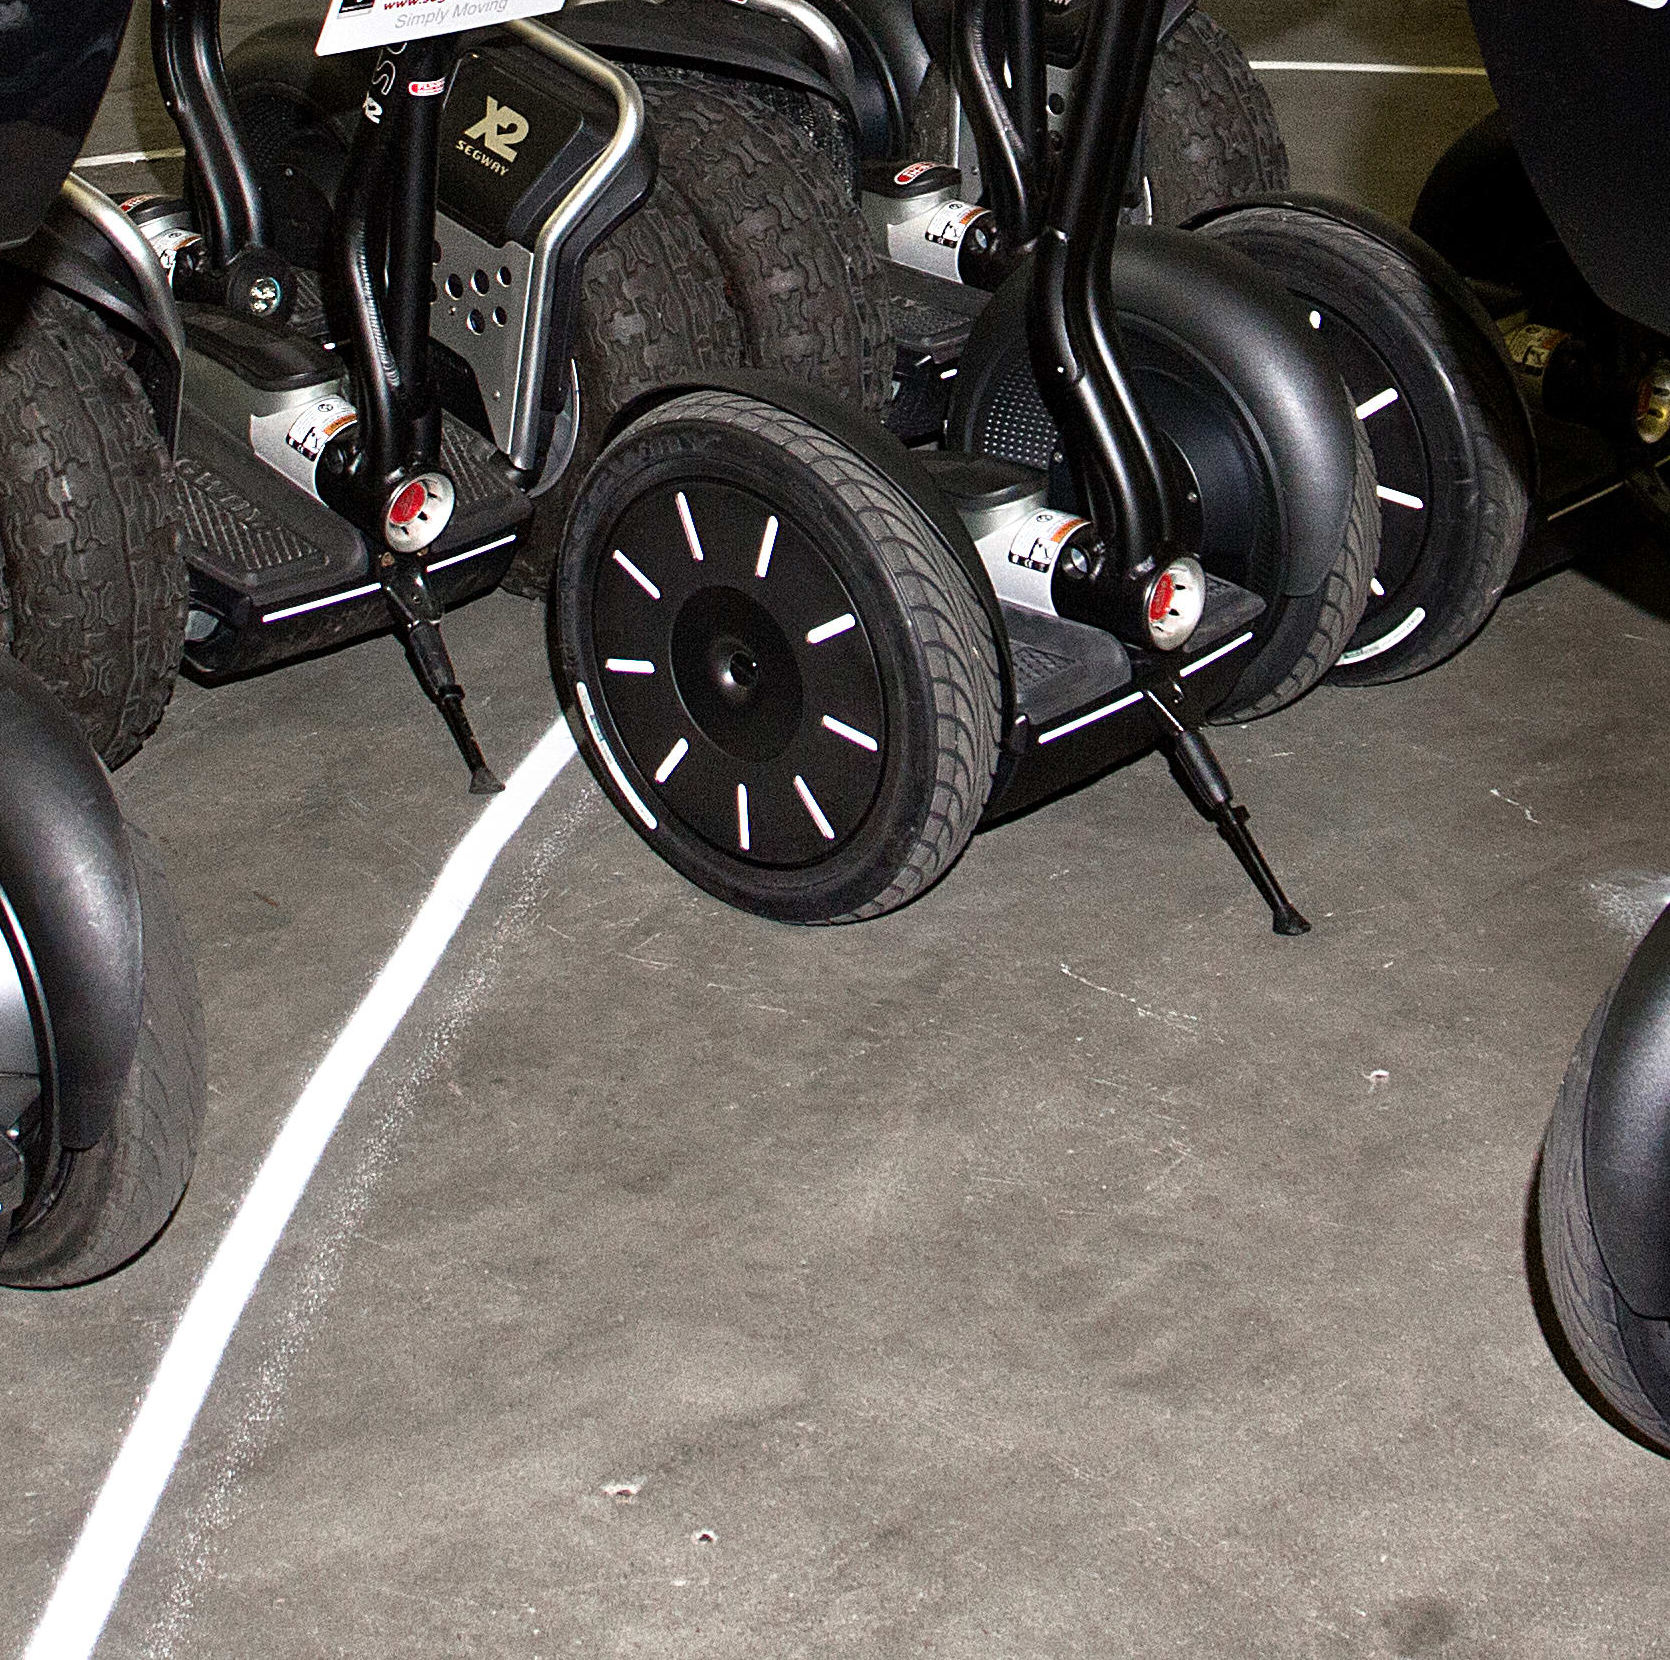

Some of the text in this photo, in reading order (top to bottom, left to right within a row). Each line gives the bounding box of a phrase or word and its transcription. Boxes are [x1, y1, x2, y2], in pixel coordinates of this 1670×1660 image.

[394, 5, 449, 29] Simply
[464, 95, 529, 163] X2
[455, 140, 510, 176] SEGWAY
